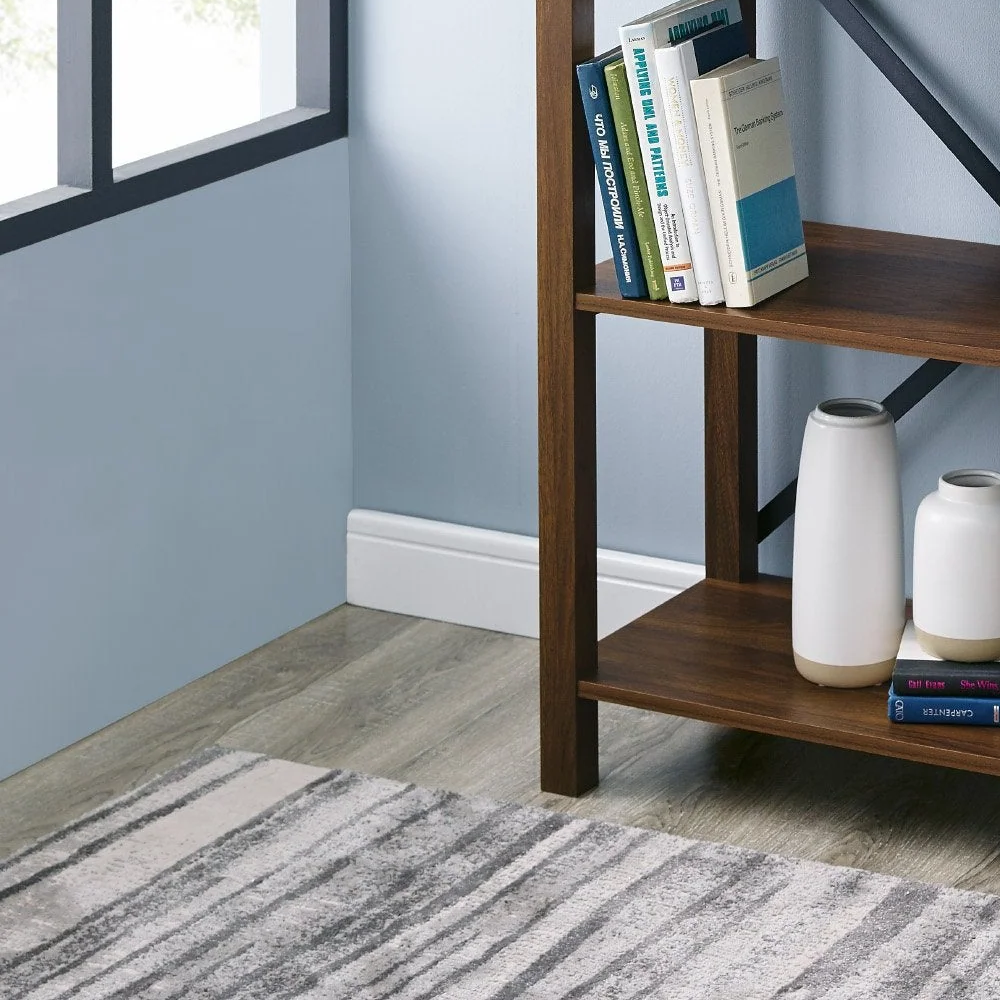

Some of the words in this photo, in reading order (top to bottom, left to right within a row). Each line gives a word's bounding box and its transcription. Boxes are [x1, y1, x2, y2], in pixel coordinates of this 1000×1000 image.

[632, 47, 653, 96] APPLYING
[642, 98, 654, 120] UML
[594, 112, 606, 137] ЧТО
[668, 76, 681, 117] WOMEN
[676, 128, 690, 167] MONEY
[646, 122, 660, 144] AND
[597, 138, 611, 159] МЫ
[627, 156, 635, 170] Eve
[650, 146, 669, 198] PATTERNS
[602, 159, 625, 232] ПОСТРОИЛИ
[925, 679, 945, 689] Evans
[960, 679, 975, 689] She
[923, 707, 973, 718] CARPENTER
